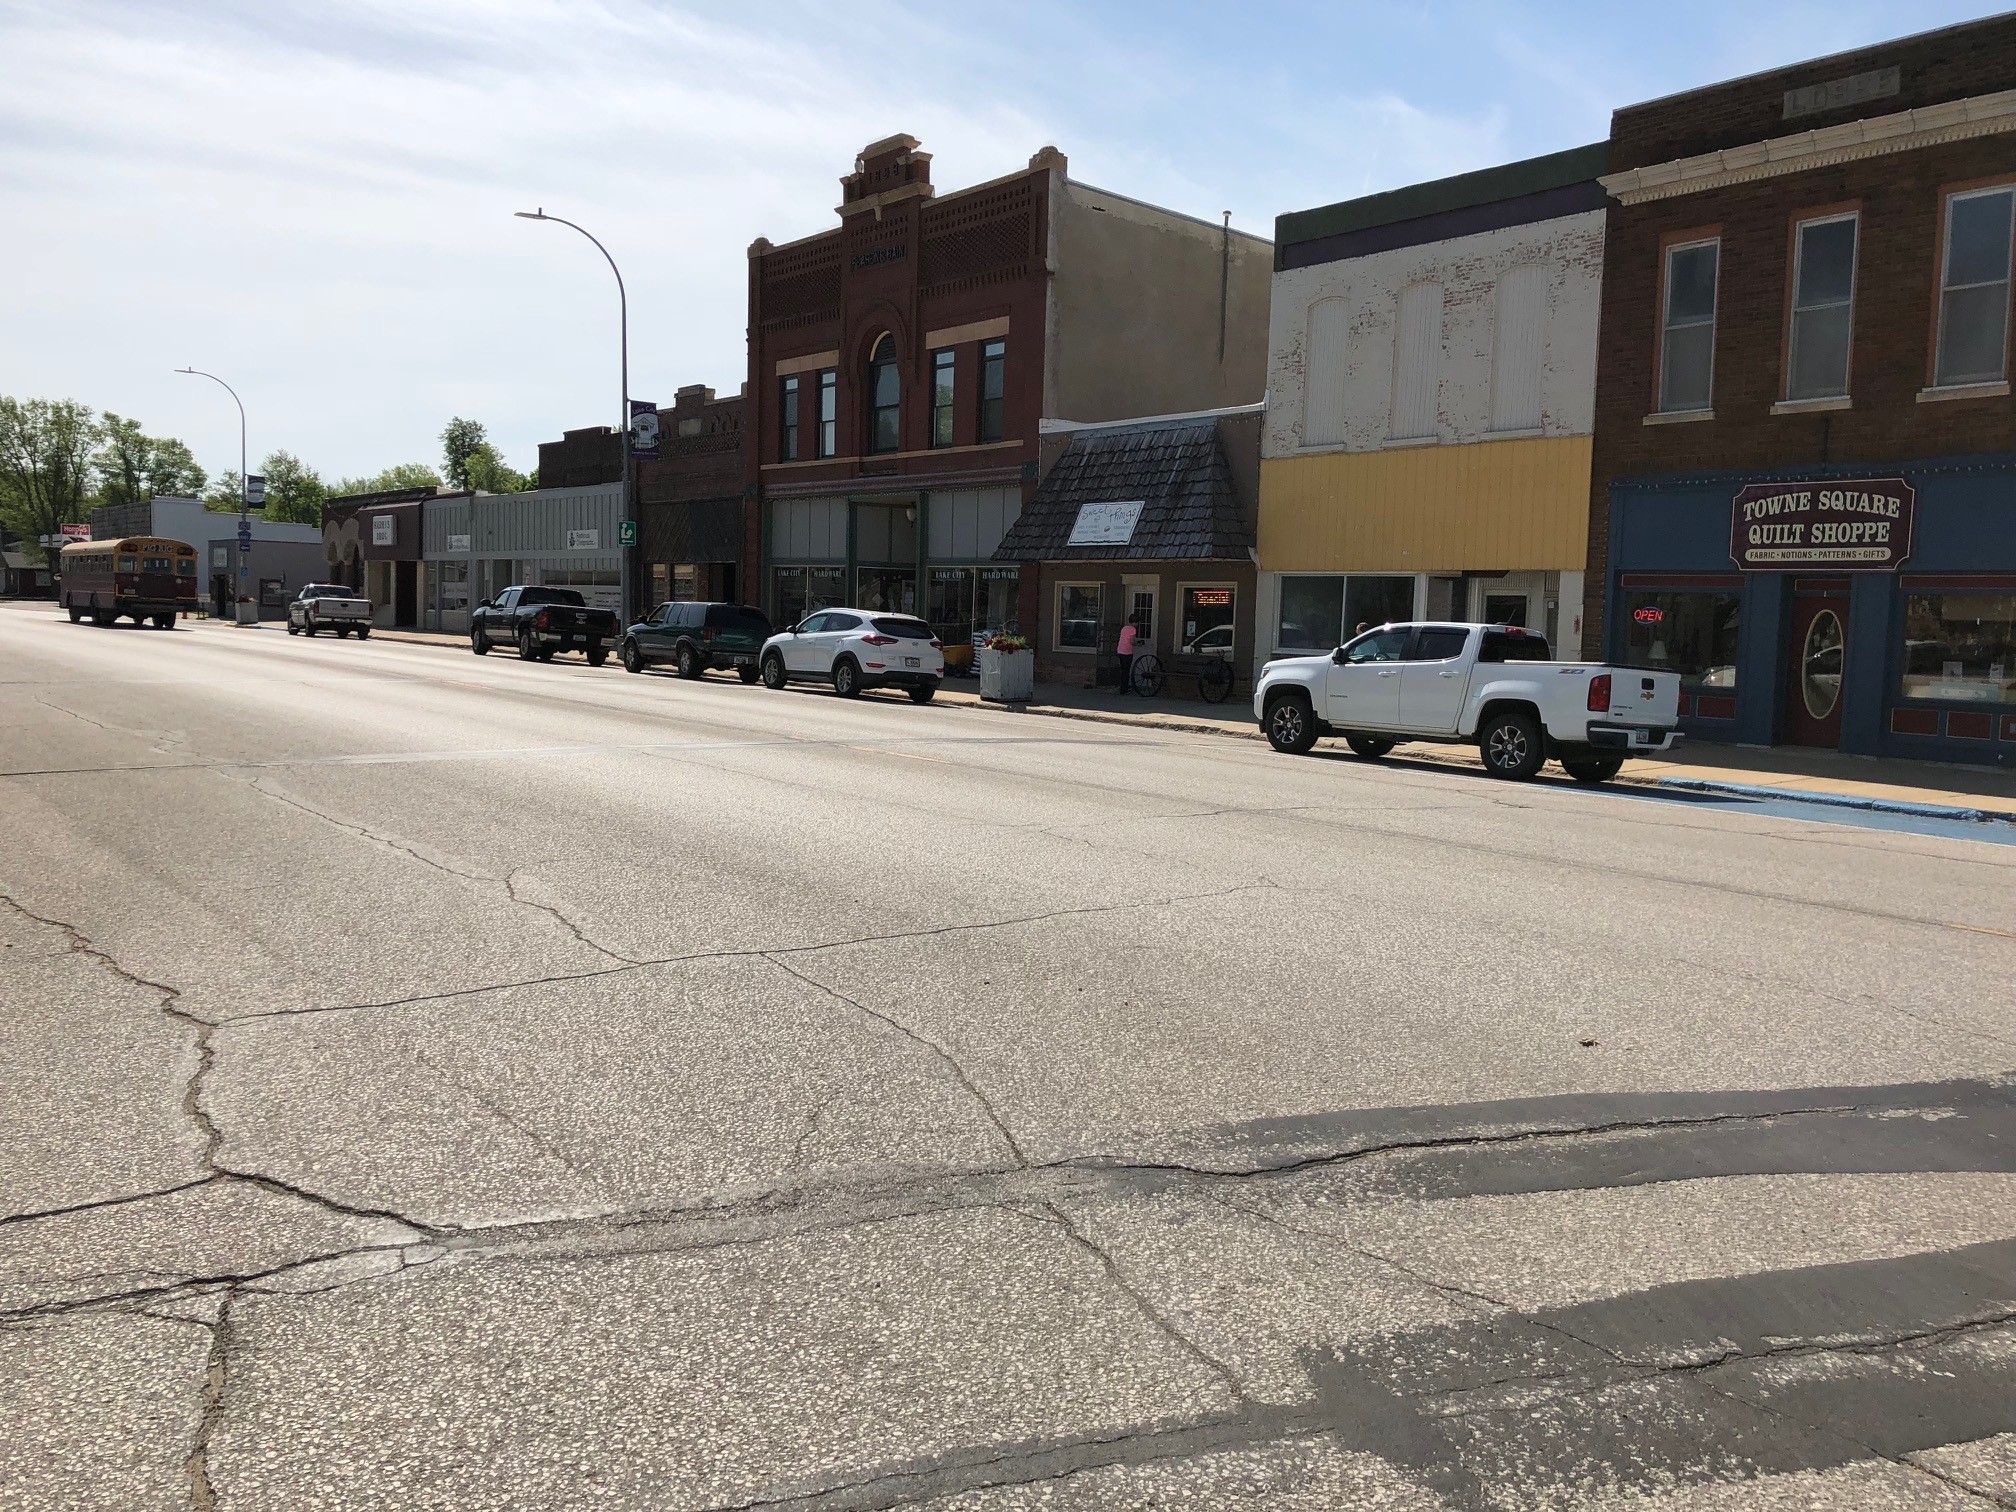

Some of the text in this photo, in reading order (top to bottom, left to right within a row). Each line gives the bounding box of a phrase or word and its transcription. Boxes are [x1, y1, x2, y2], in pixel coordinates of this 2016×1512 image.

[1743, 490, 1901, 522] TOWNE SQUARE
[1748, 522, 1890, 545] QUILT SHOPPE
[1750, 550, 1886, 560] FABRIC NOTIONS PATTERNS GIFTS
[935, 571, 965, 579] LAKE CITY
[982, 571, 1019, 580] HARDWARE
[1634, 609, 1664, 621] OPEN
